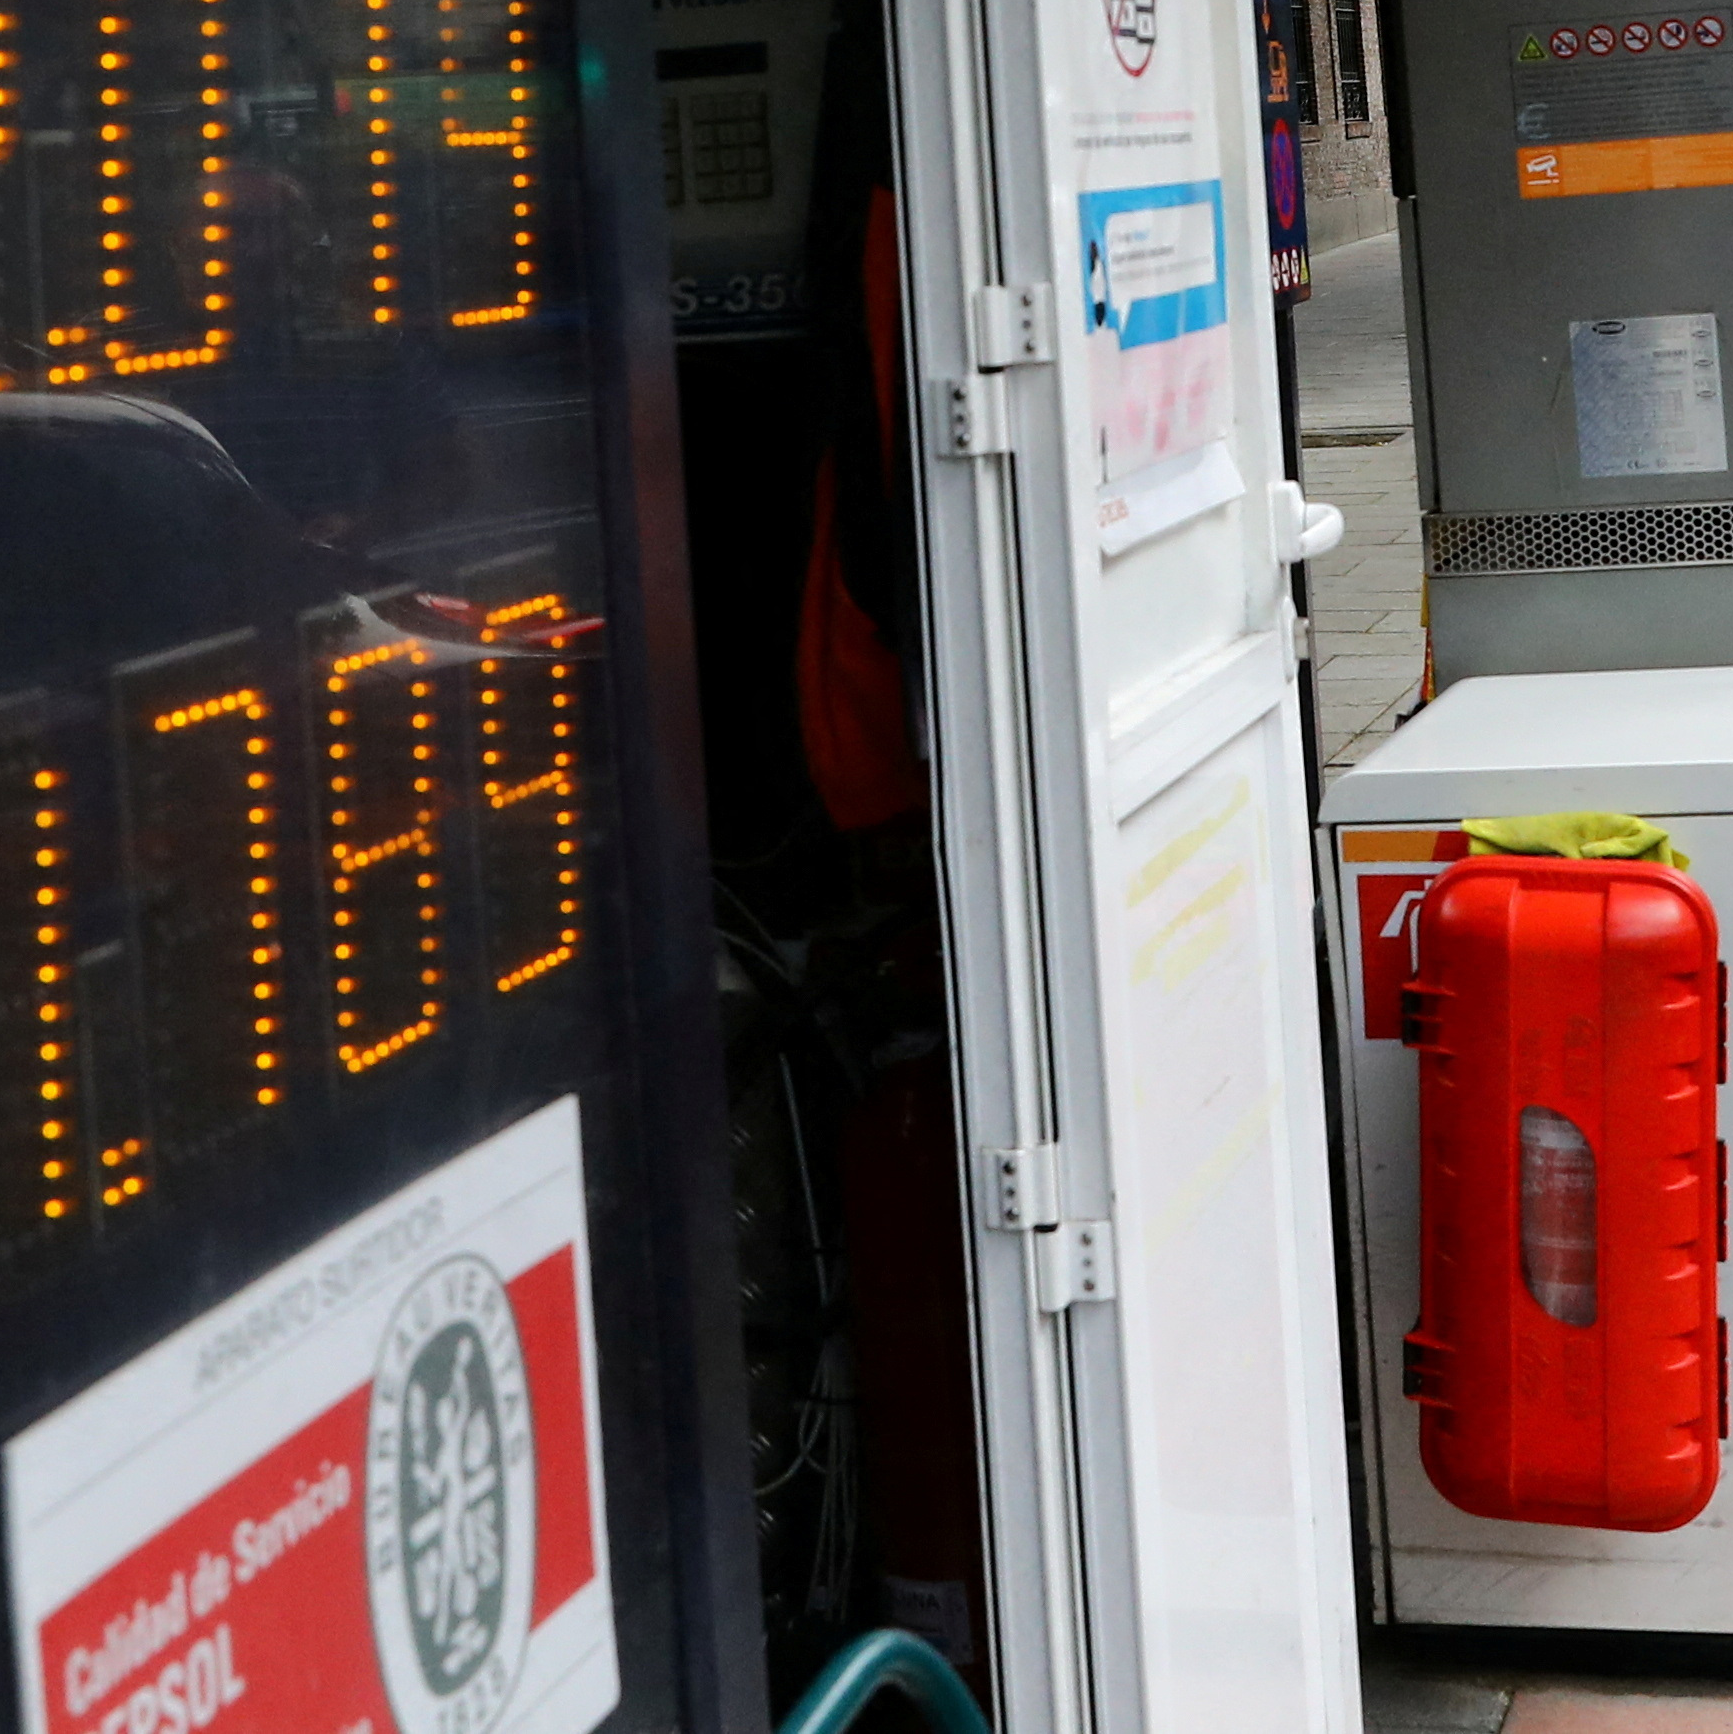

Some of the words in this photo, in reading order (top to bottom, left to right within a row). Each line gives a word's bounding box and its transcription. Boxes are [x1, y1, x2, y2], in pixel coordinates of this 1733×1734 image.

[33, 593, 580, 1220] 1.789
[65, 1569, 188, 1716] Calidad
[190, 1551, 231, 1617] de
[233, 1459, 351, 1585] Servicio
[82, 1622, 246, 1734] PSOL
